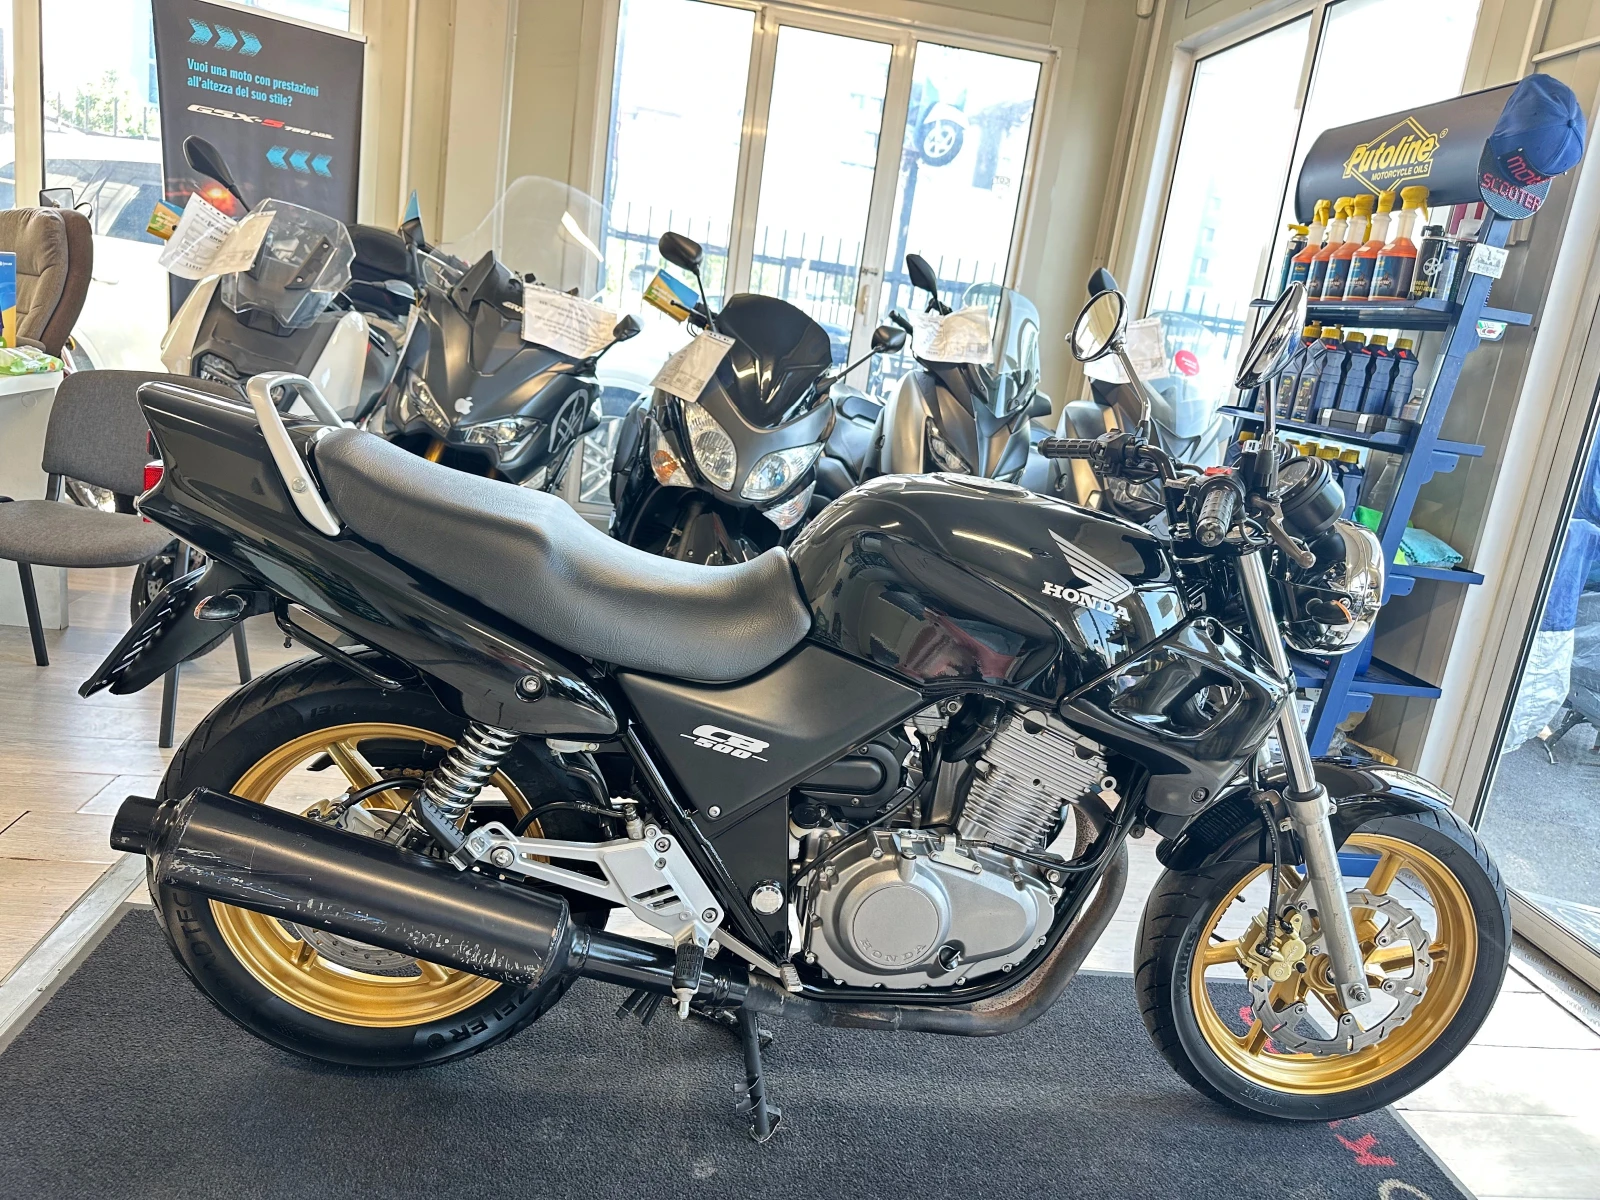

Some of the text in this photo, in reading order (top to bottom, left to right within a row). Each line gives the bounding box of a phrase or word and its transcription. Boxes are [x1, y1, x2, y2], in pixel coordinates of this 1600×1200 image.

[187, 58, 319, 97] Vuoi una moto con prestazioni
[187, 75, 293, 107] all’altezza del suo stile?
[1345, 134, 1436, 176] Putoline
[1371, 164, 1429, 182] MOTORCYCLE OILS
[1481, 172, 1542, 212] SCOOTER
[1042, 581, 1131, 622] HONDA
[692, 724, 770, 754] CB
[693, 737, 753, 759] 500
[859, 937, 928, 963] HONDA
[448, 990, 533, 1043] ZELER
